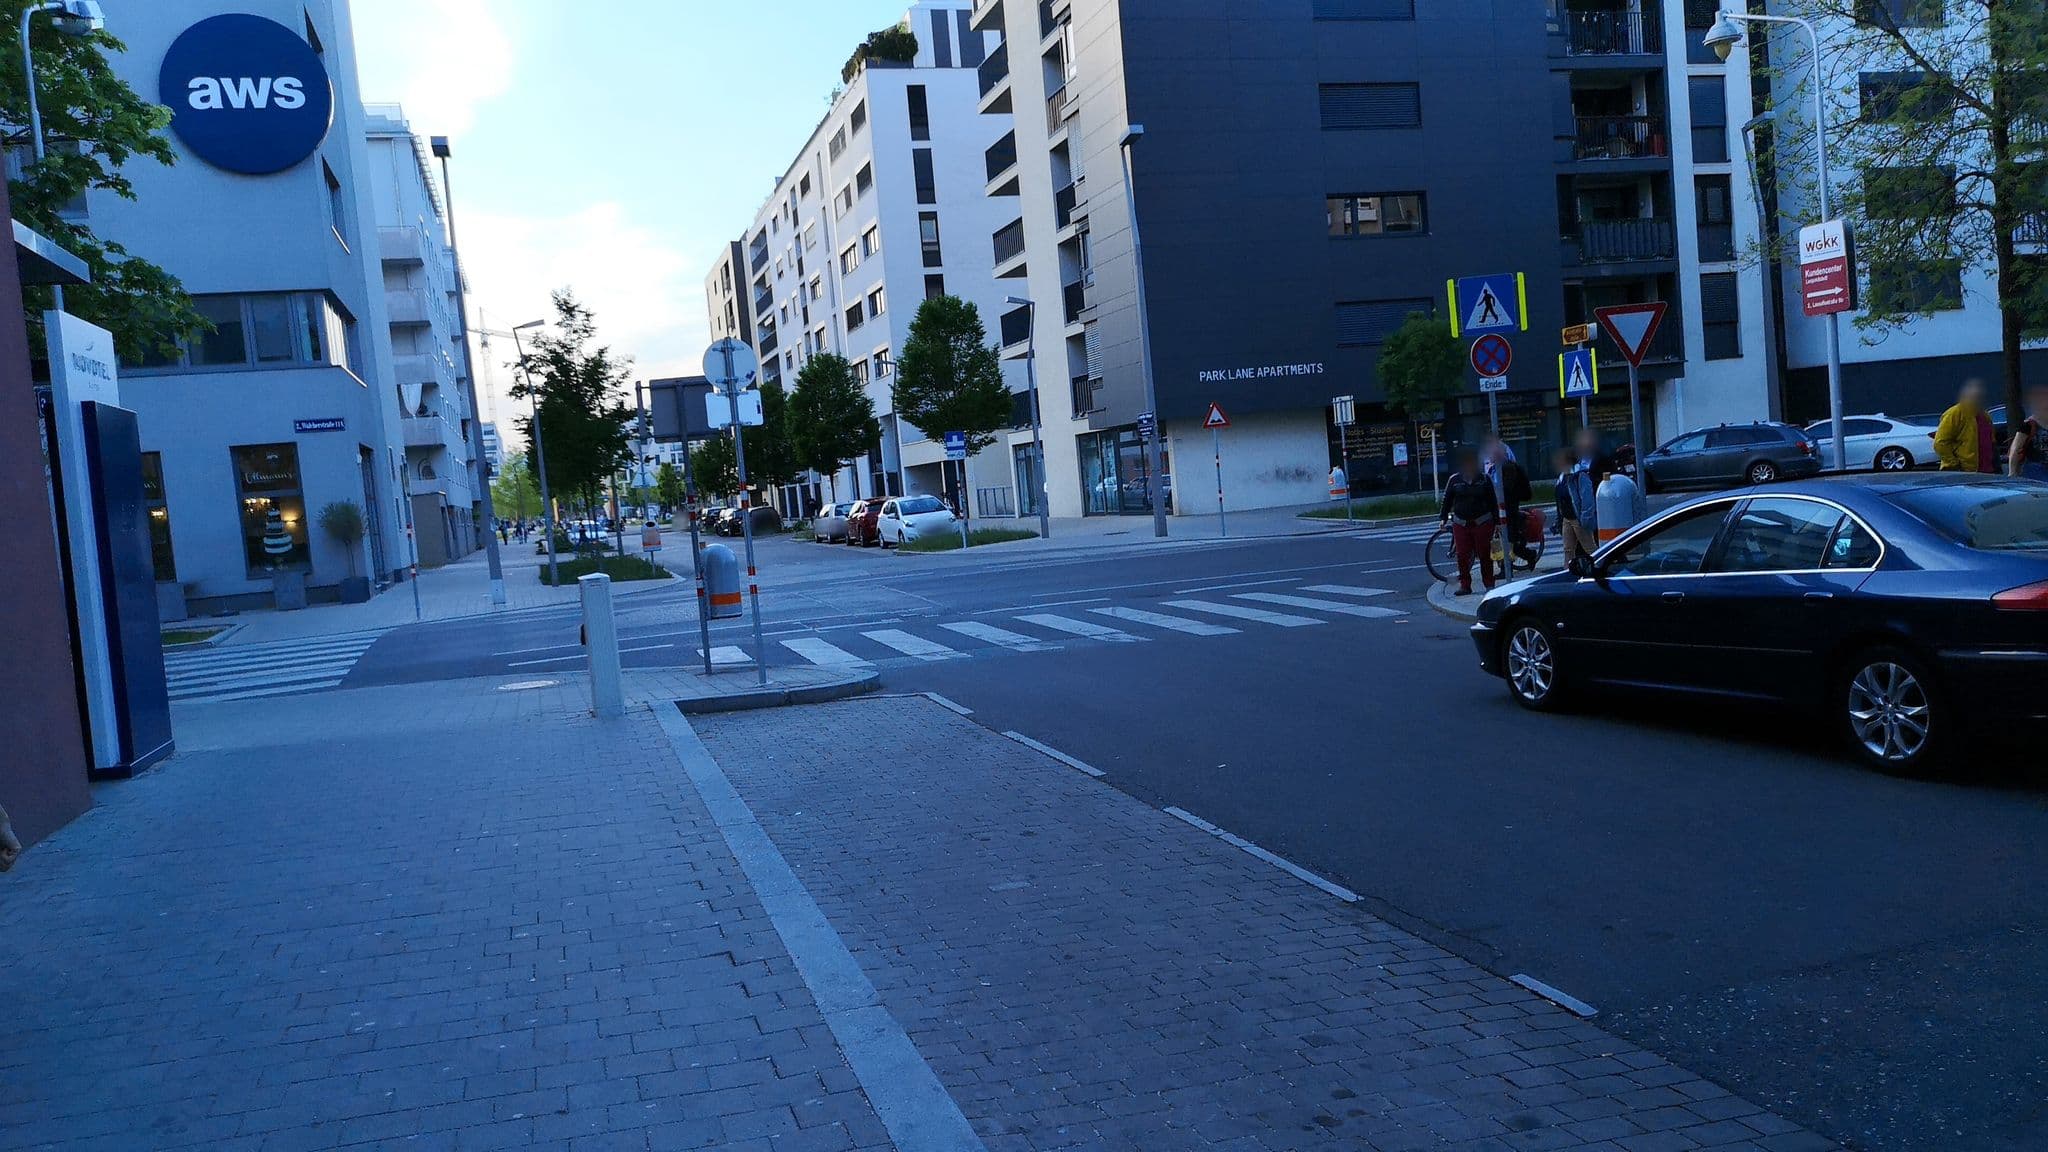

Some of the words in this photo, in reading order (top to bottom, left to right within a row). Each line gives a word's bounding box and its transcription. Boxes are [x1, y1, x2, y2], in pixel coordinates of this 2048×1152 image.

[188, 76, 306, 110] aws
[1806, 229, 1839, 252] WGKK
[1805, 264, 1842, 278] Kundencenter
[1199, 369, 1226, 382] PARK
[1228, 367, 1255, 380] LANE
[1256, 362, 1324, 378] APARTMENTS
[1485, 380, 1503, 389] Ende
